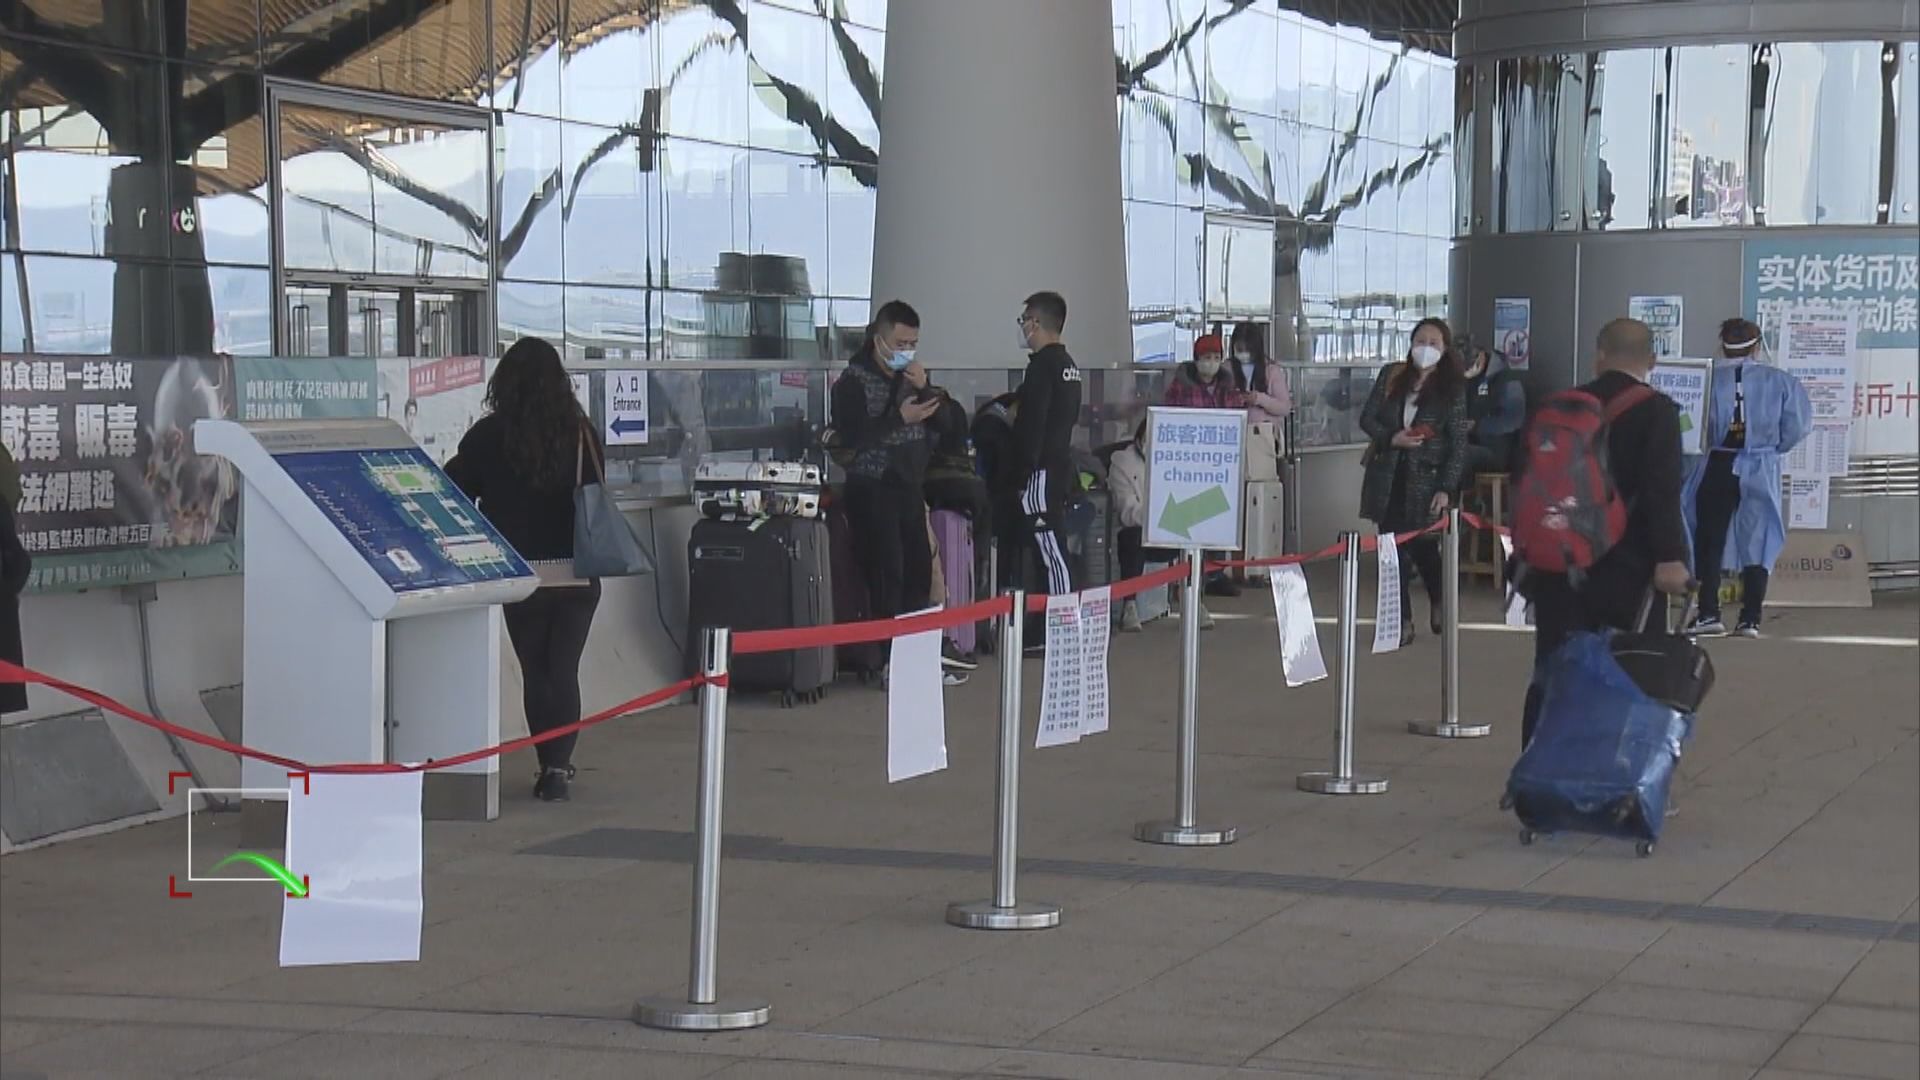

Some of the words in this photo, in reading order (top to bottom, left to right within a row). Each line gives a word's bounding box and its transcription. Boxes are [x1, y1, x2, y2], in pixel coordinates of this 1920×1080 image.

[1757, 254, 1918, 293] 实体货币及
[615, 376, 638, 393] 入口
[613, 396, 641, 411] Entrance
[1157, 424, 1238, 445] 旅客通道
[1154, 450, 1240, 466] passenger
[1163, 467, 1229, 483] channel
[17, 470, 115, 513] 法網難逃
